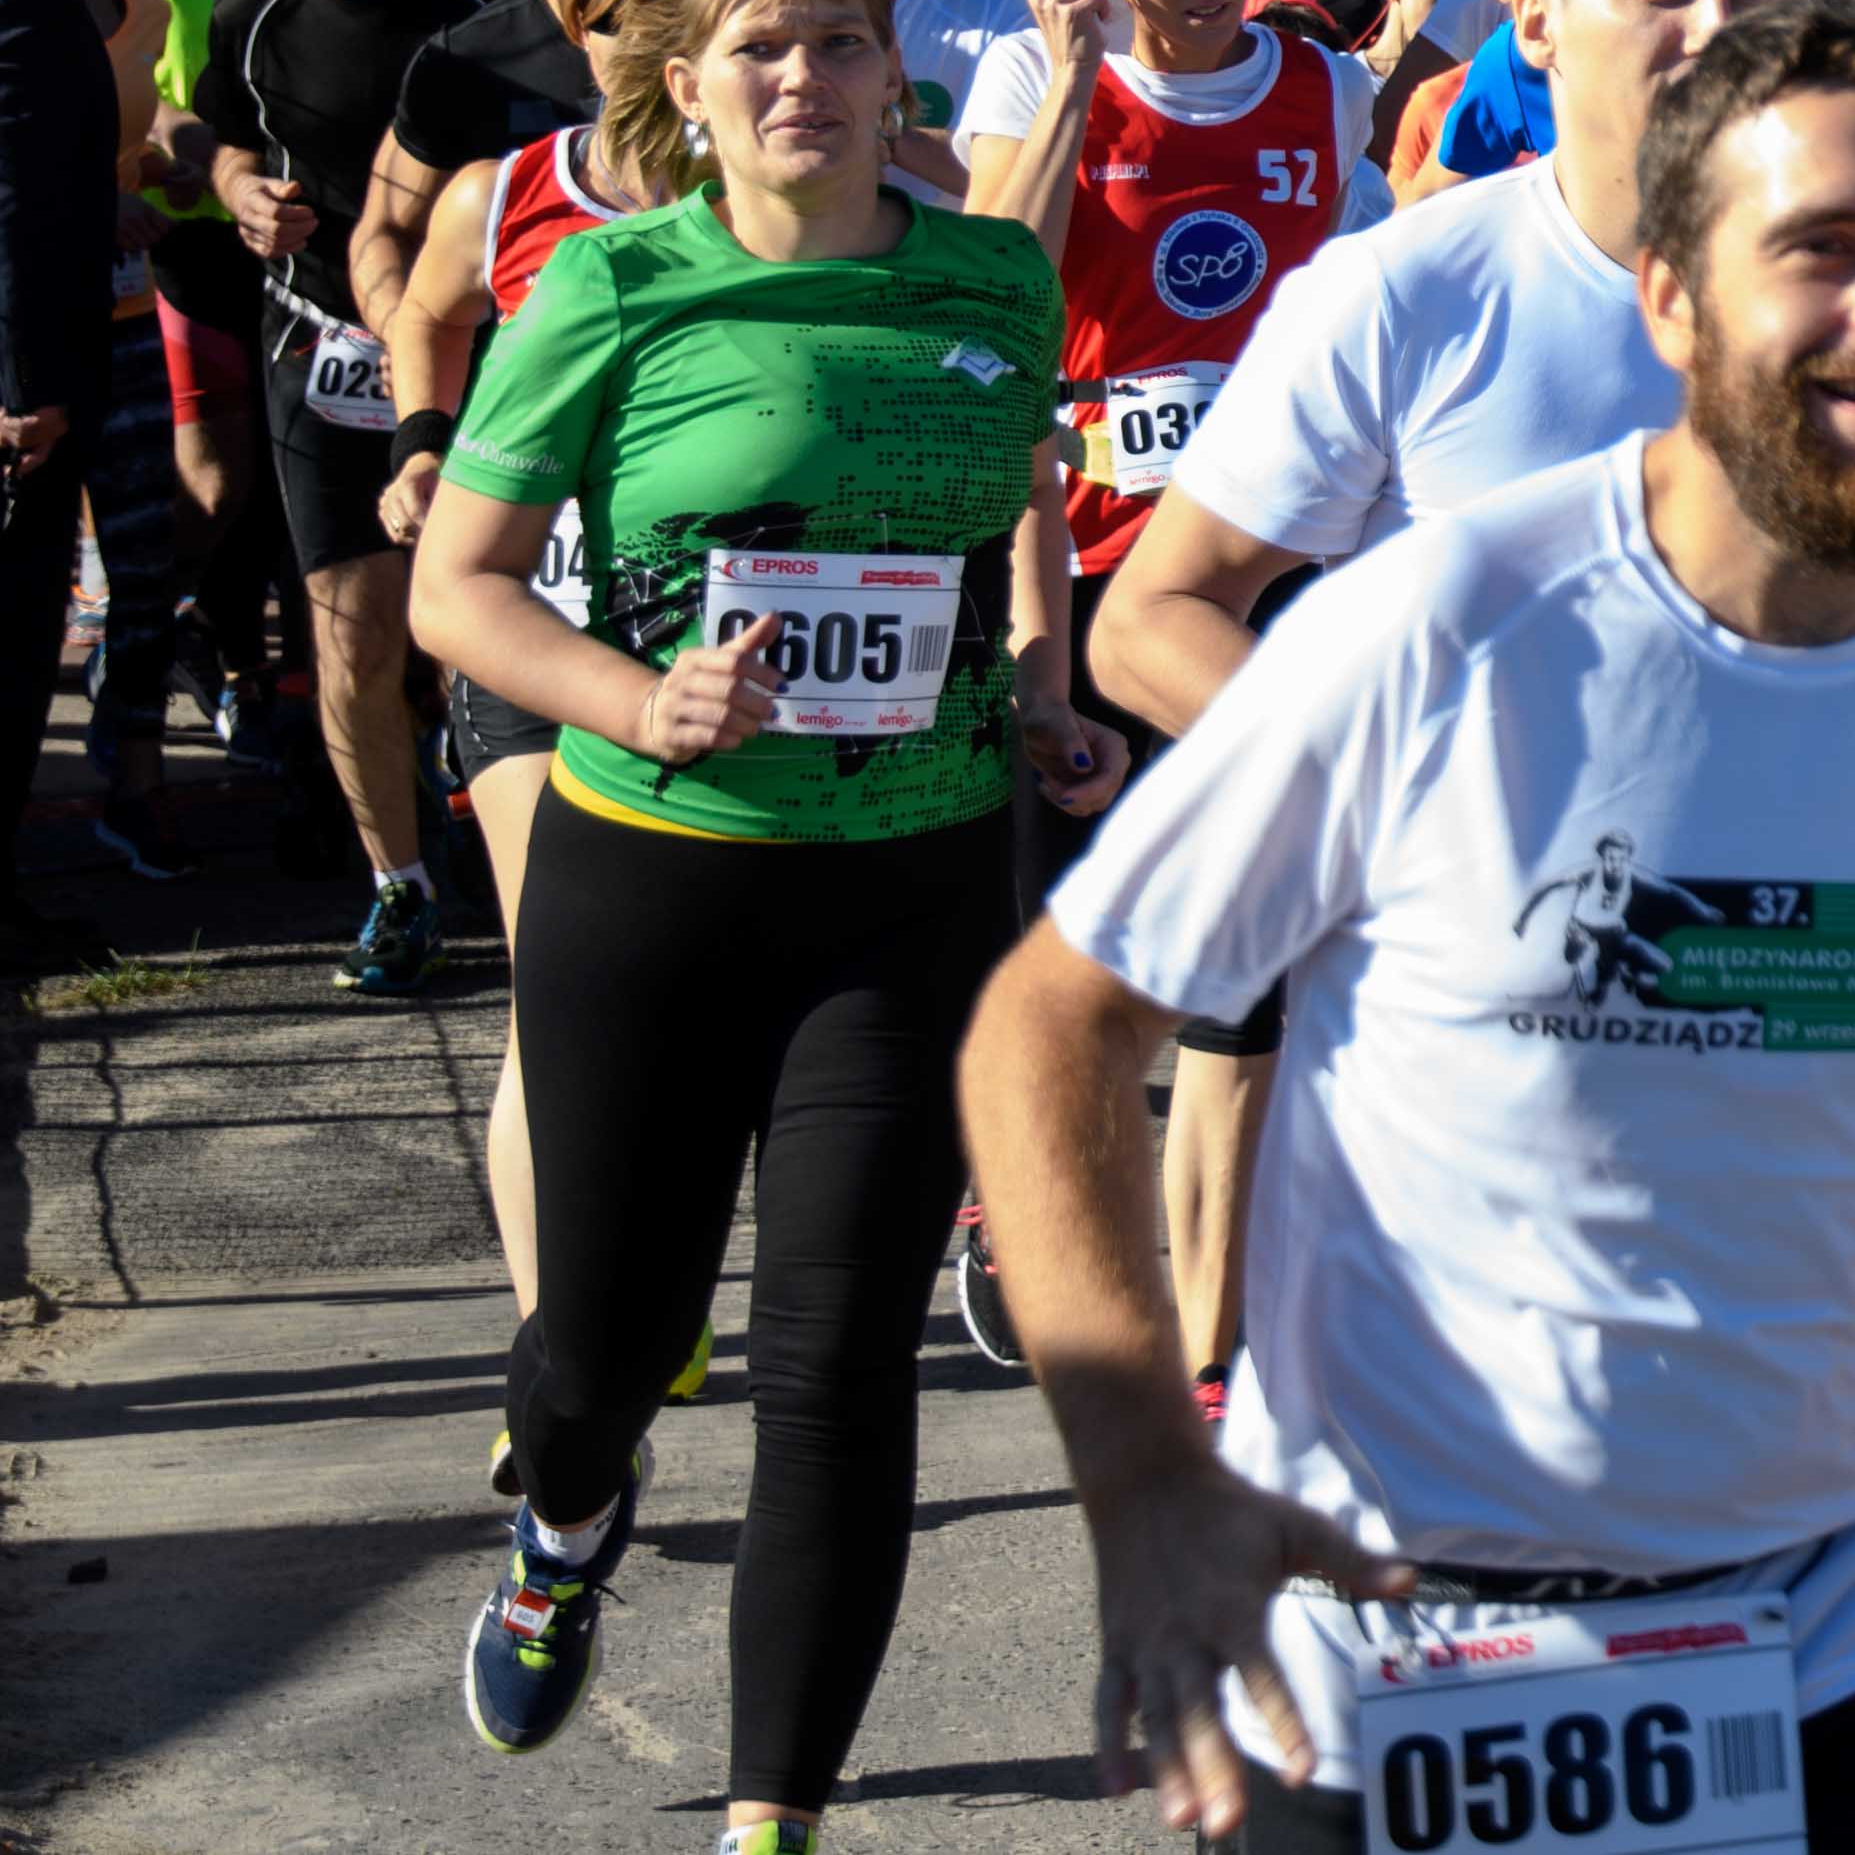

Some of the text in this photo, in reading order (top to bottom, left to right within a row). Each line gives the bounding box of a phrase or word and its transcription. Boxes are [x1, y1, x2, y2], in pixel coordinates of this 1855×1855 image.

[1257, 148, 1319, 207] 52
[752, 558, 819, 575] EPROS
[797, 712, 843, 729] lemigo
[878, 713, 913, 726] lemigo
[1752, 886, 1809, 926] 37.
[1507, 1010, 1763, 1055] GRUDZIĄDZ
[1427, 1633, 1535, 1669] EPROS
[1383, 1702, 1697, 1853] 0586
